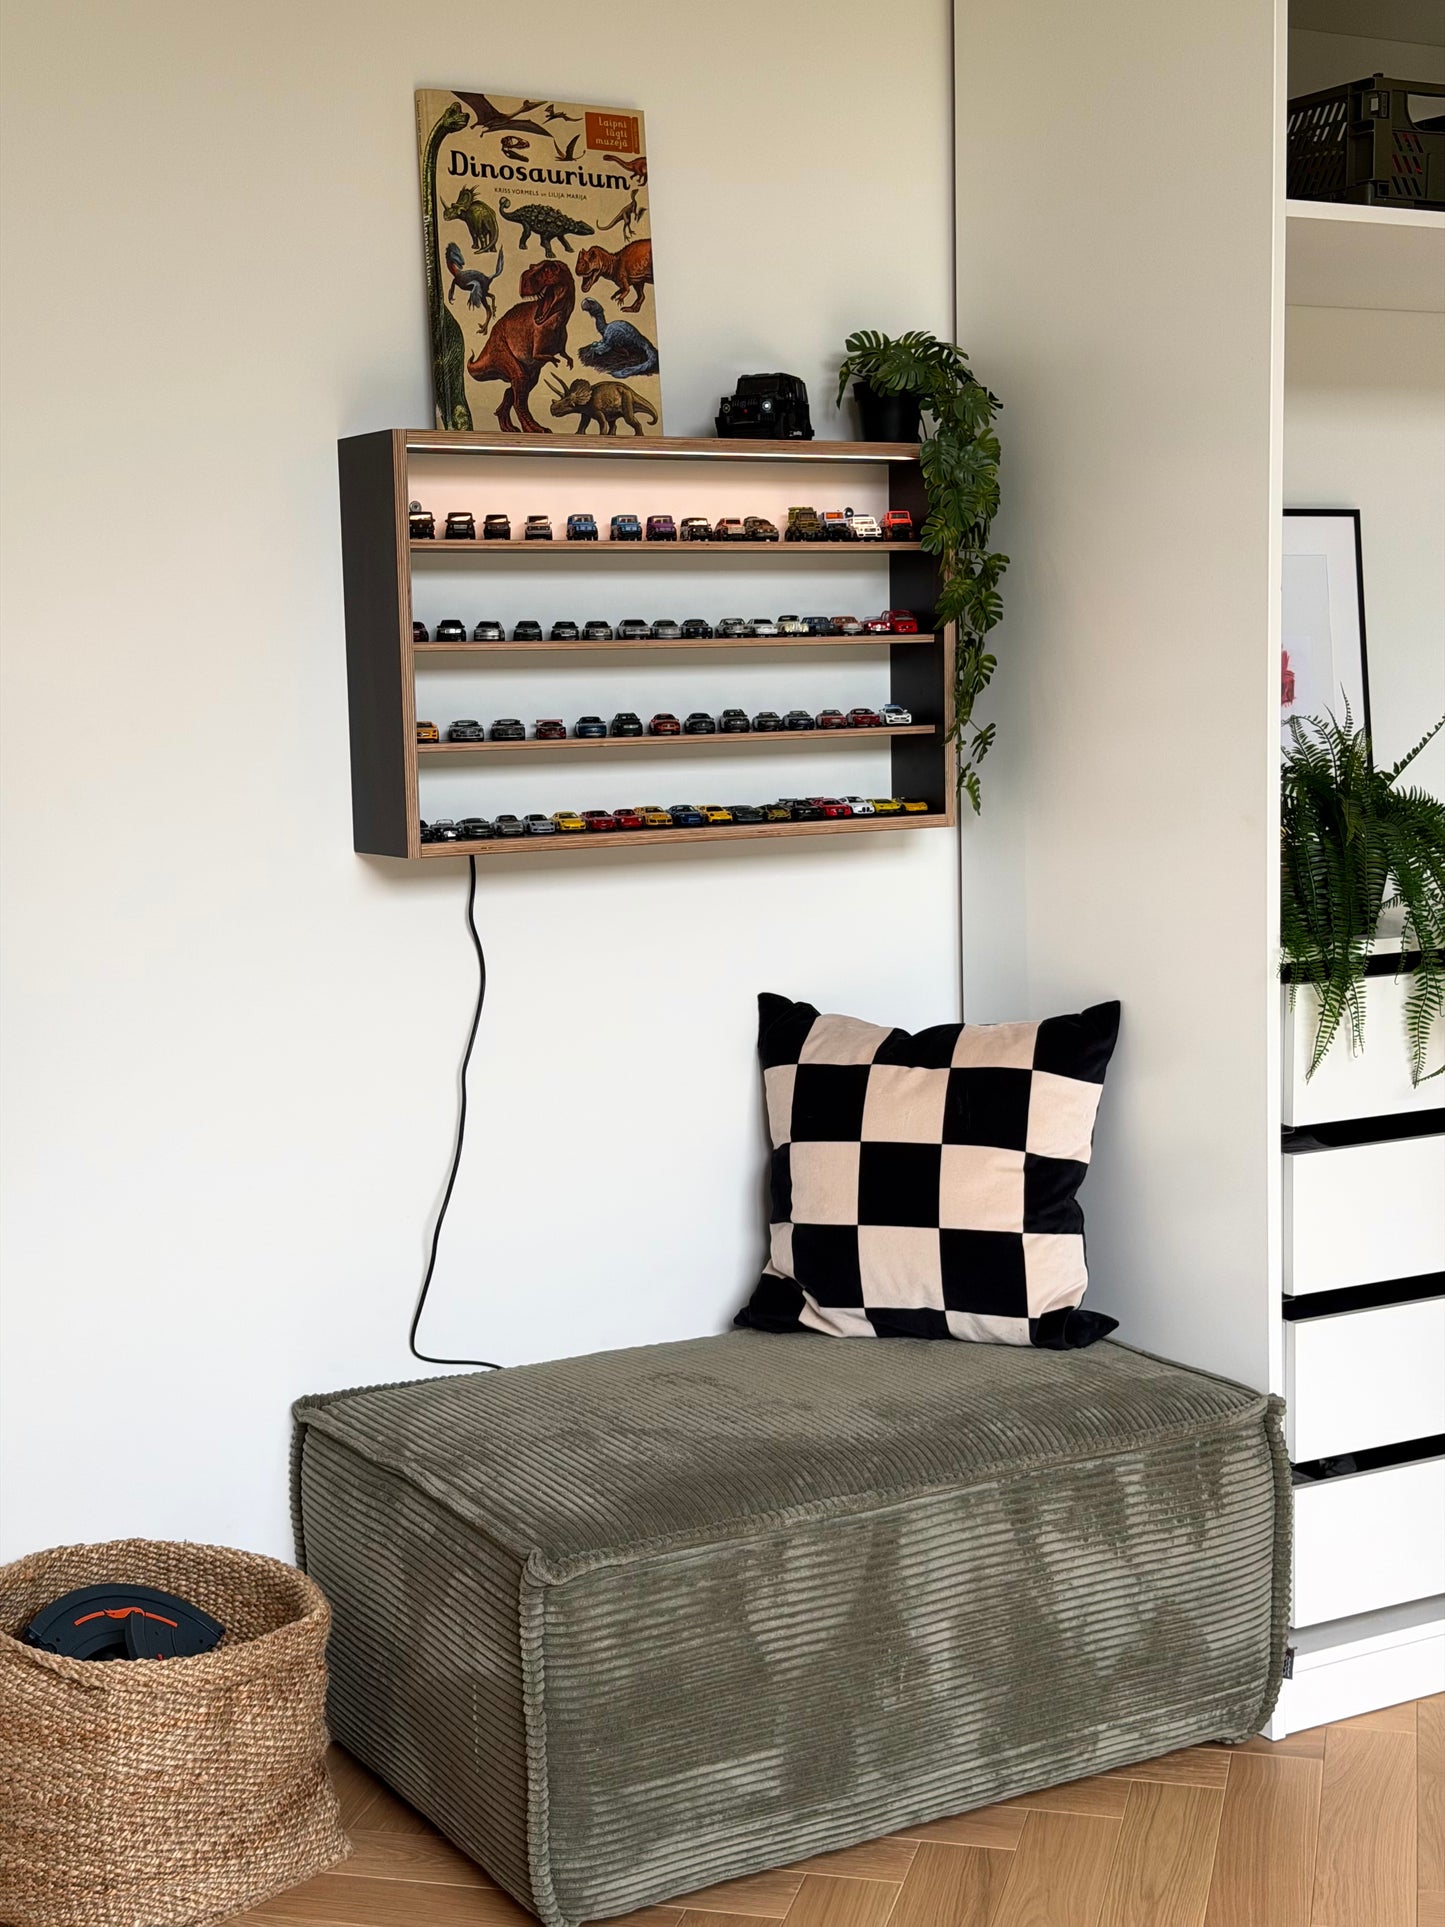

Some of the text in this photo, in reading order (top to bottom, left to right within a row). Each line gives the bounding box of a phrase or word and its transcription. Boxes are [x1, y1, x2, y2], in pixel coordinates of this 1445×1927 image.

[598, 116, 627, 130] Laipni
[448, 150, 631, 190] Dinosaurium
[511, 188, 539, 196] VORMELS
[548, 191, 565, 199] LILIJA
[566, 193, 587, 201] MARIJA
